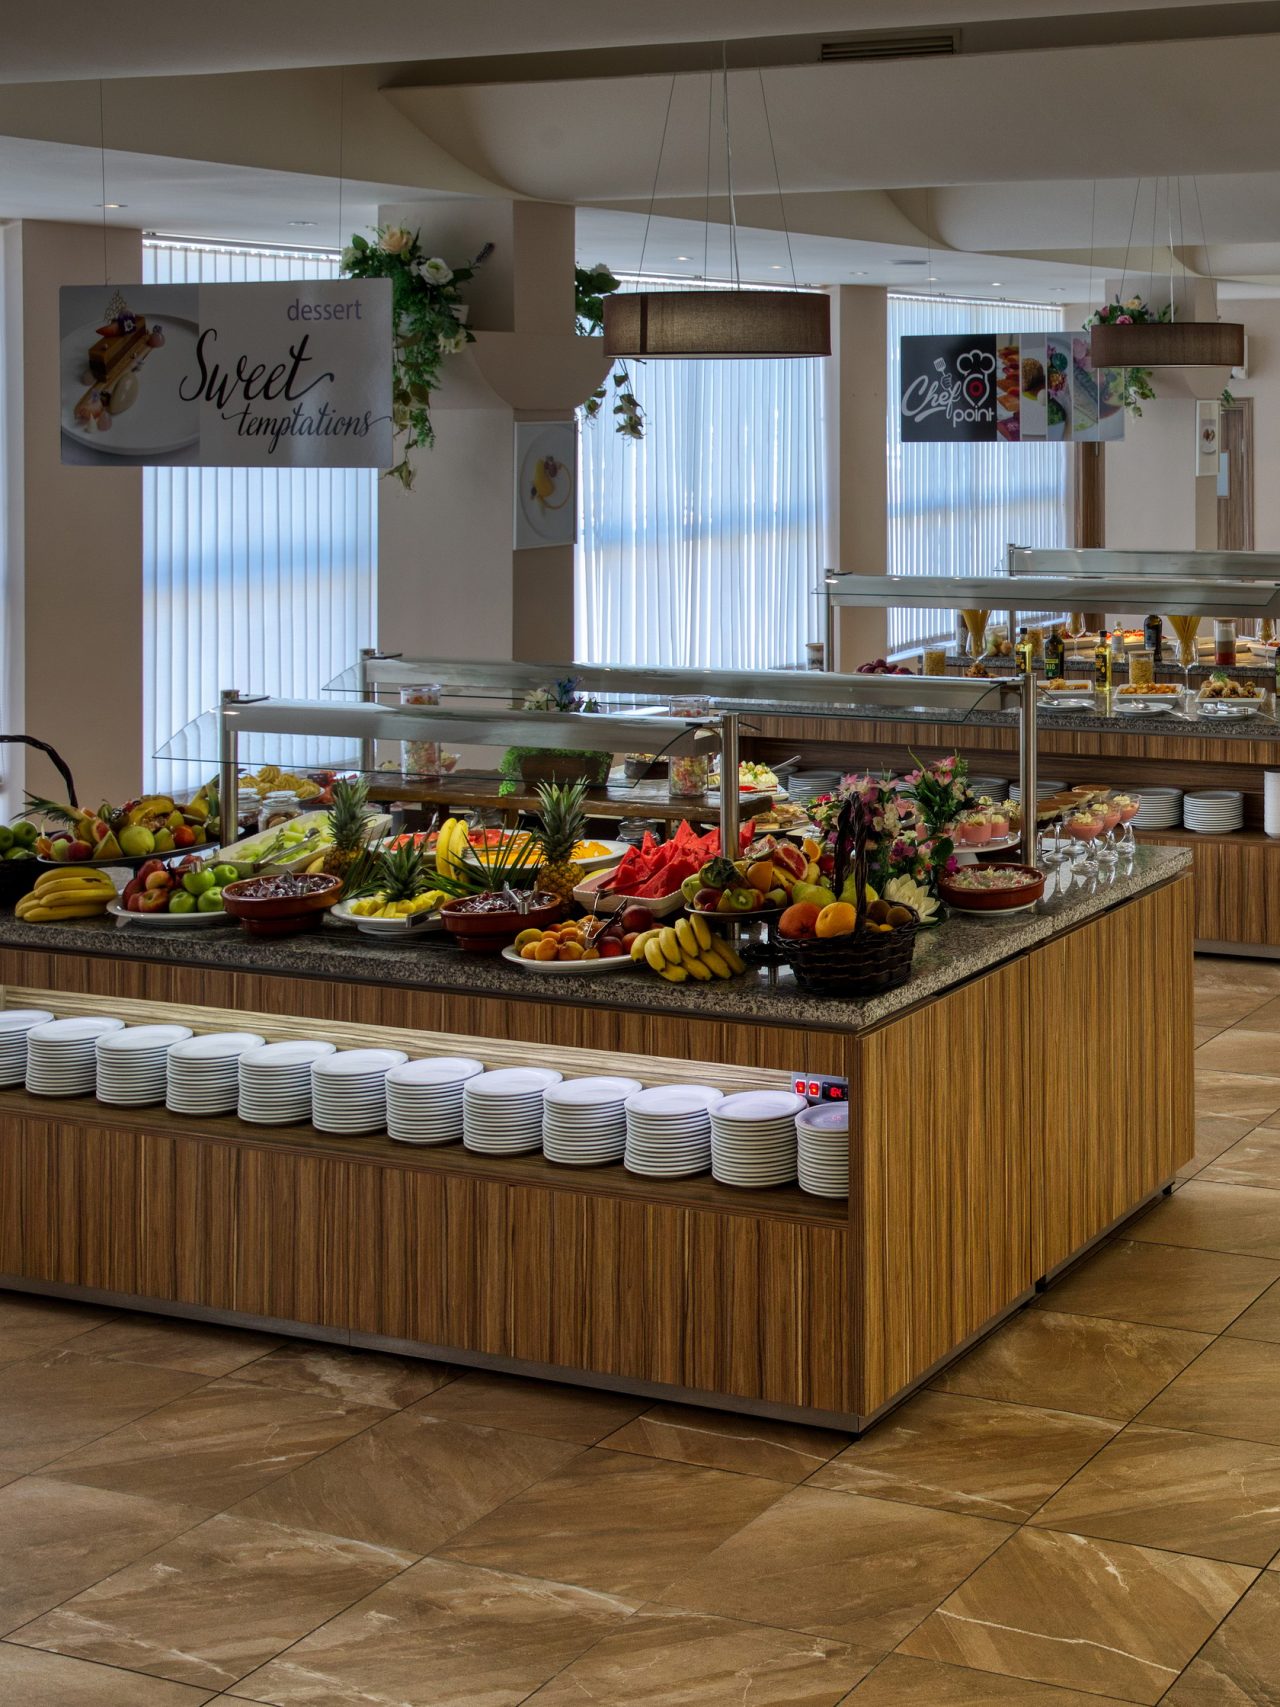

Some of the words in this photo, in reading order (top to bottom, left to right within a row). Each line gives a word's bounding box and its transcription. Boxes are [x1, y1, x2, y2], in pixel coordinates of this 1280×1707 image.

[287, 298, 362, 321] dessert
[178, 328, 335, 410] Sweet
[901, 374, 962, 423] Chef
[953, 405, 995, 428] point
[221, 402, 393, 454] temptations
